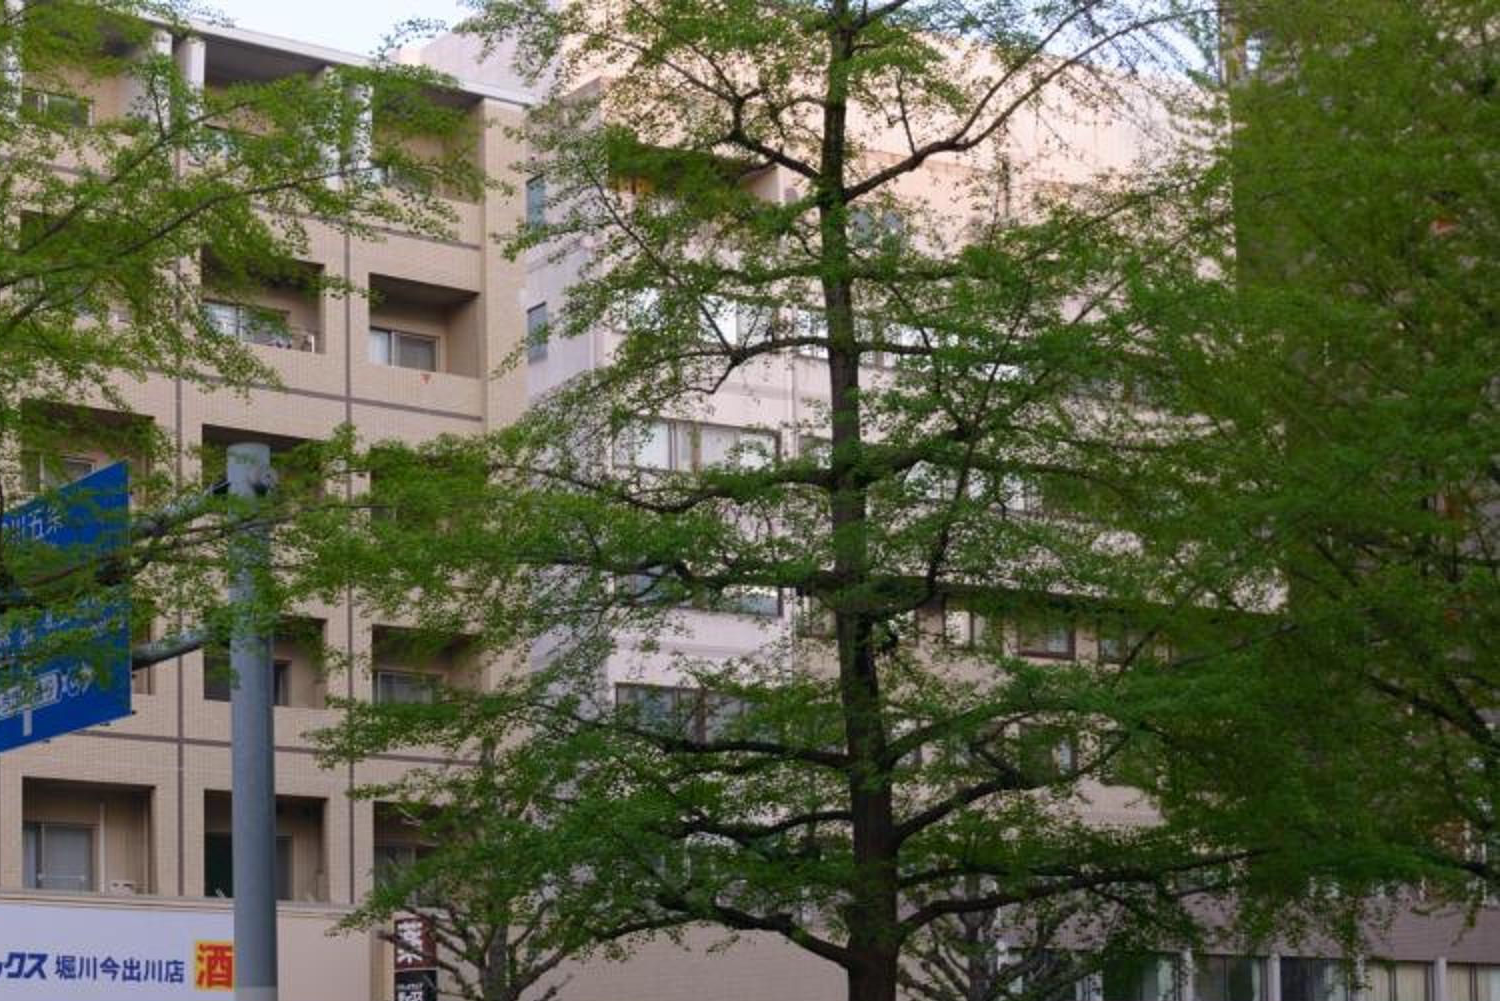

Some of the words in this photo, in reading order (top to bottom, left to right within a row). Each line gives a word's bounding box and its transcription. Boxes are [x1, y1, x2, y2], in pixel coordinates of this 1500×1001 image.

[55, 954, 186, 984] 堀川今出川店
[196, 943, 234, 989] 酒
